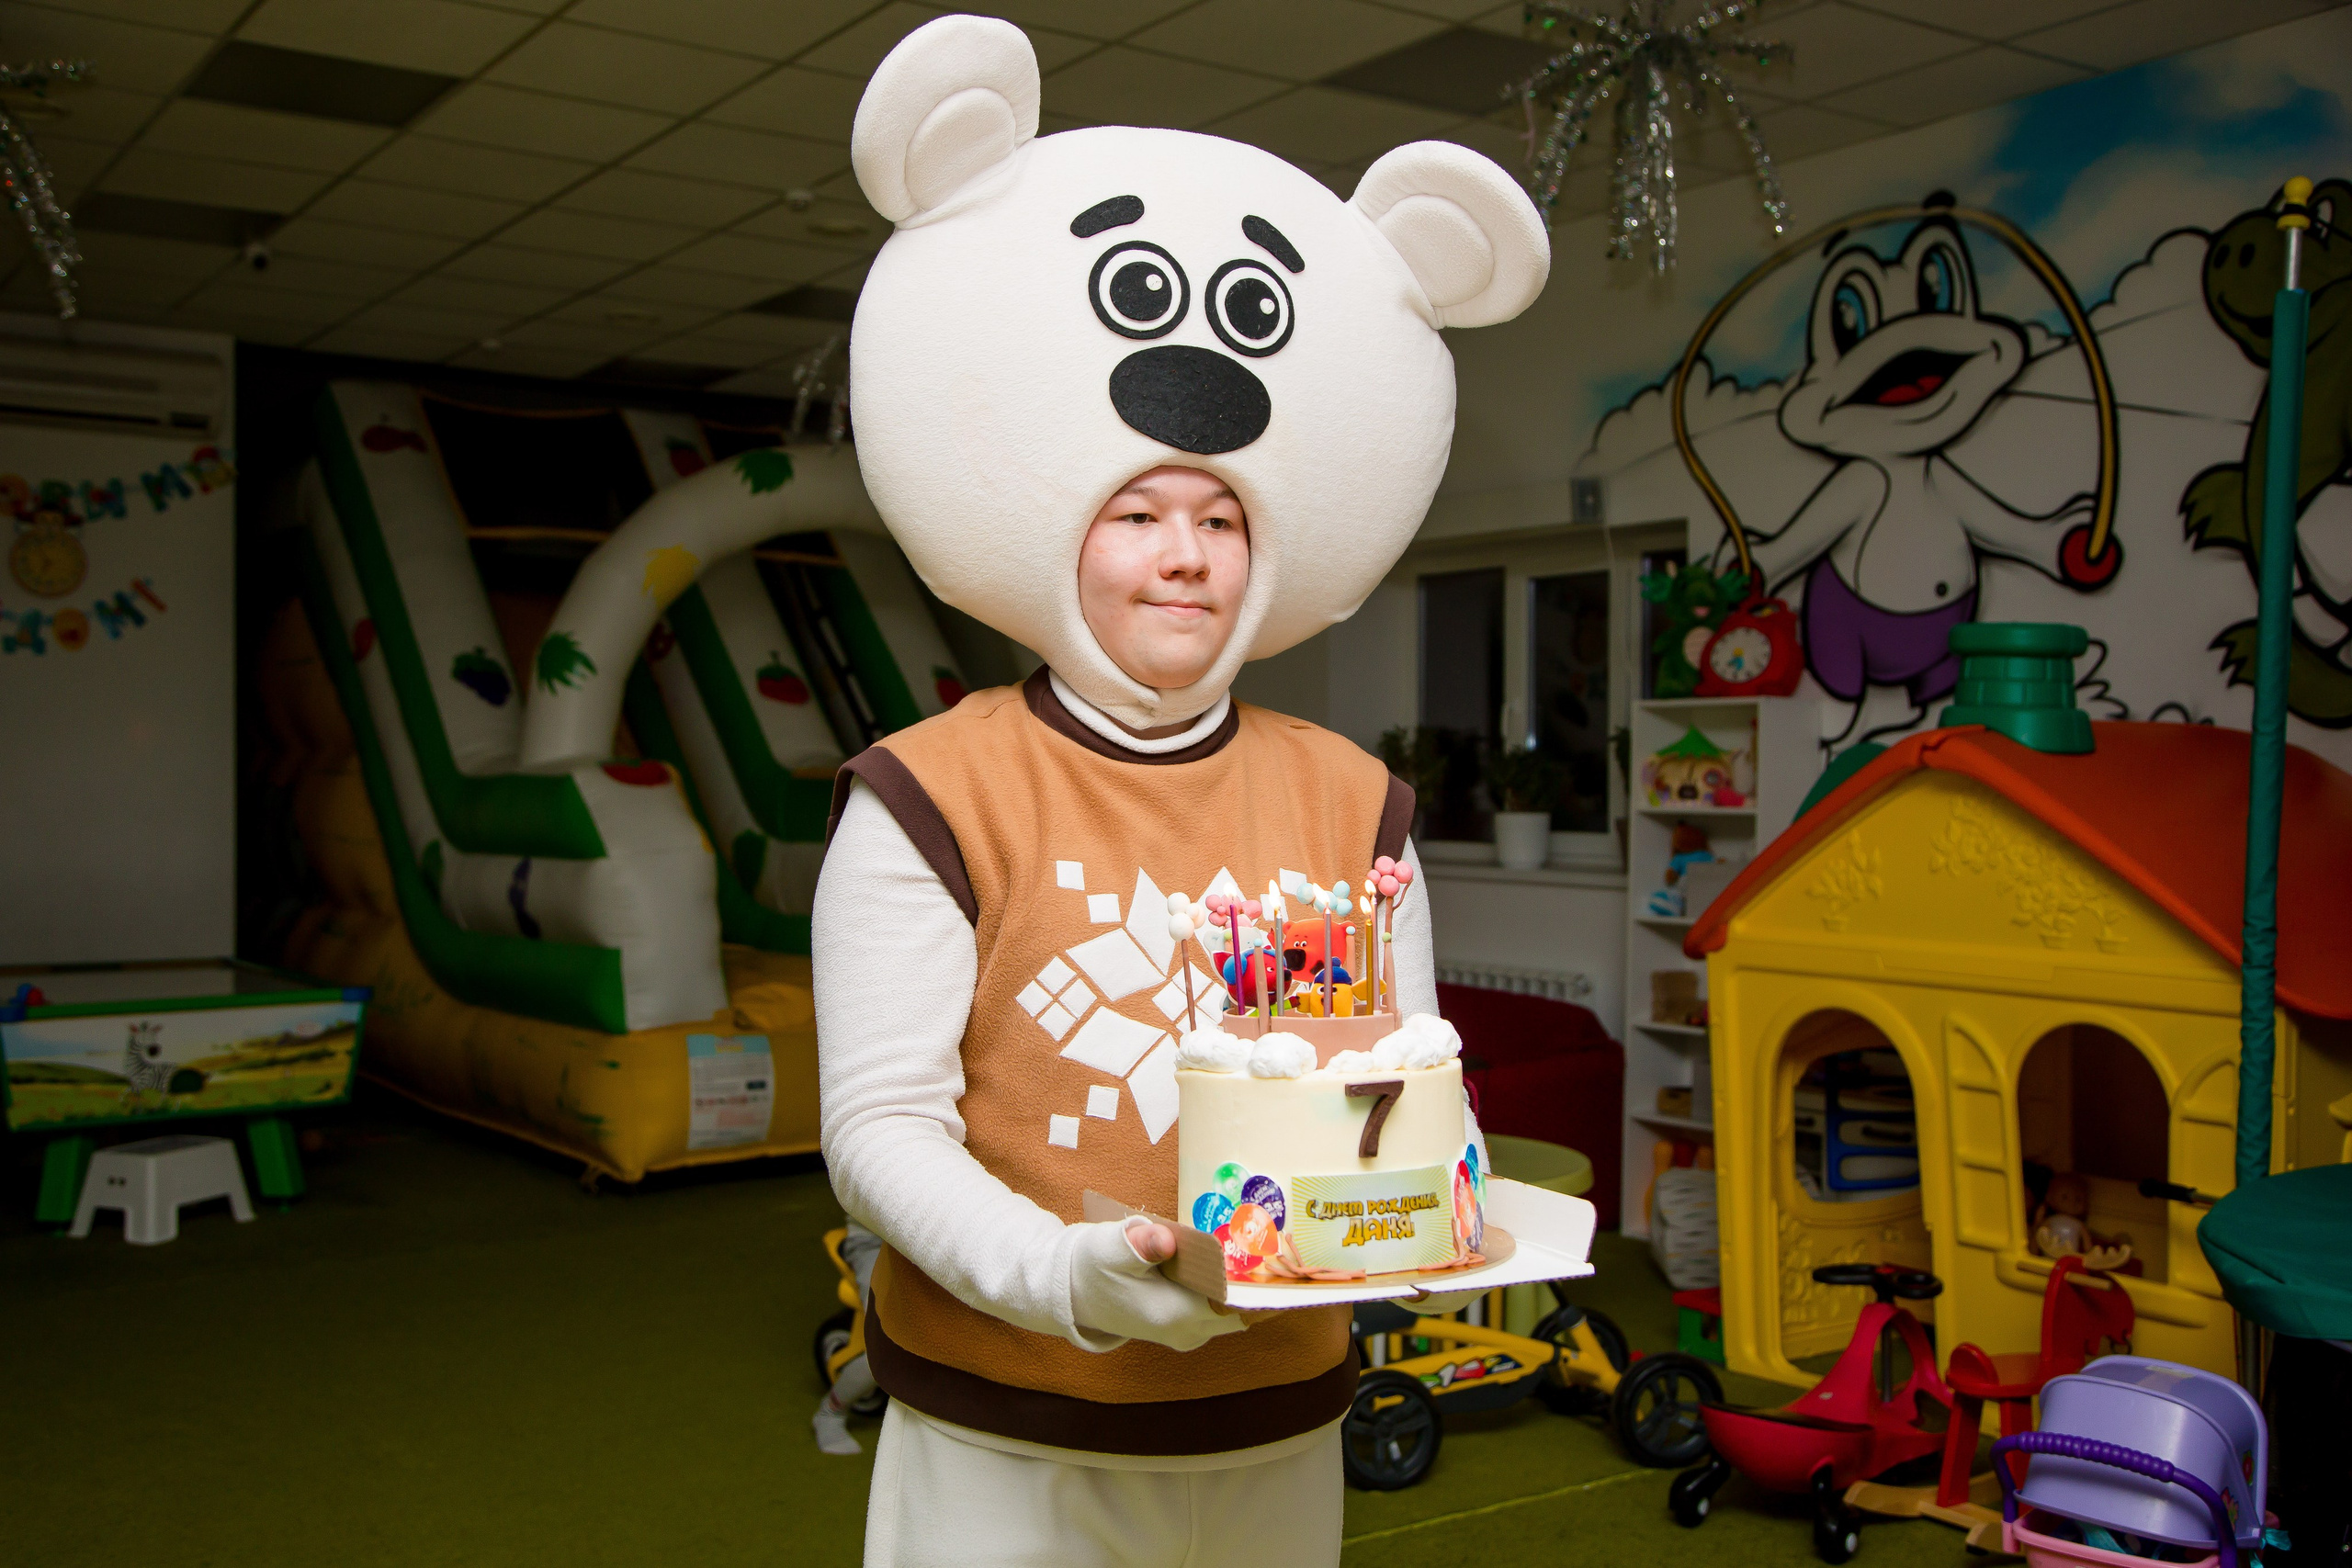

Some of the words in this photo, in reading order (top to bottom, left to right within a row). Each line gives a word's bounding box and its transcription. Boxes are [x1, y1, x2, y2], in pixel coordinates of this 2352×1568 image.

[1345, 1078, 1404, 1157] 7
[1306, 1199, 1317, 1219] С
[1342, 1213, 1415, 1247] ДАНЯ!
